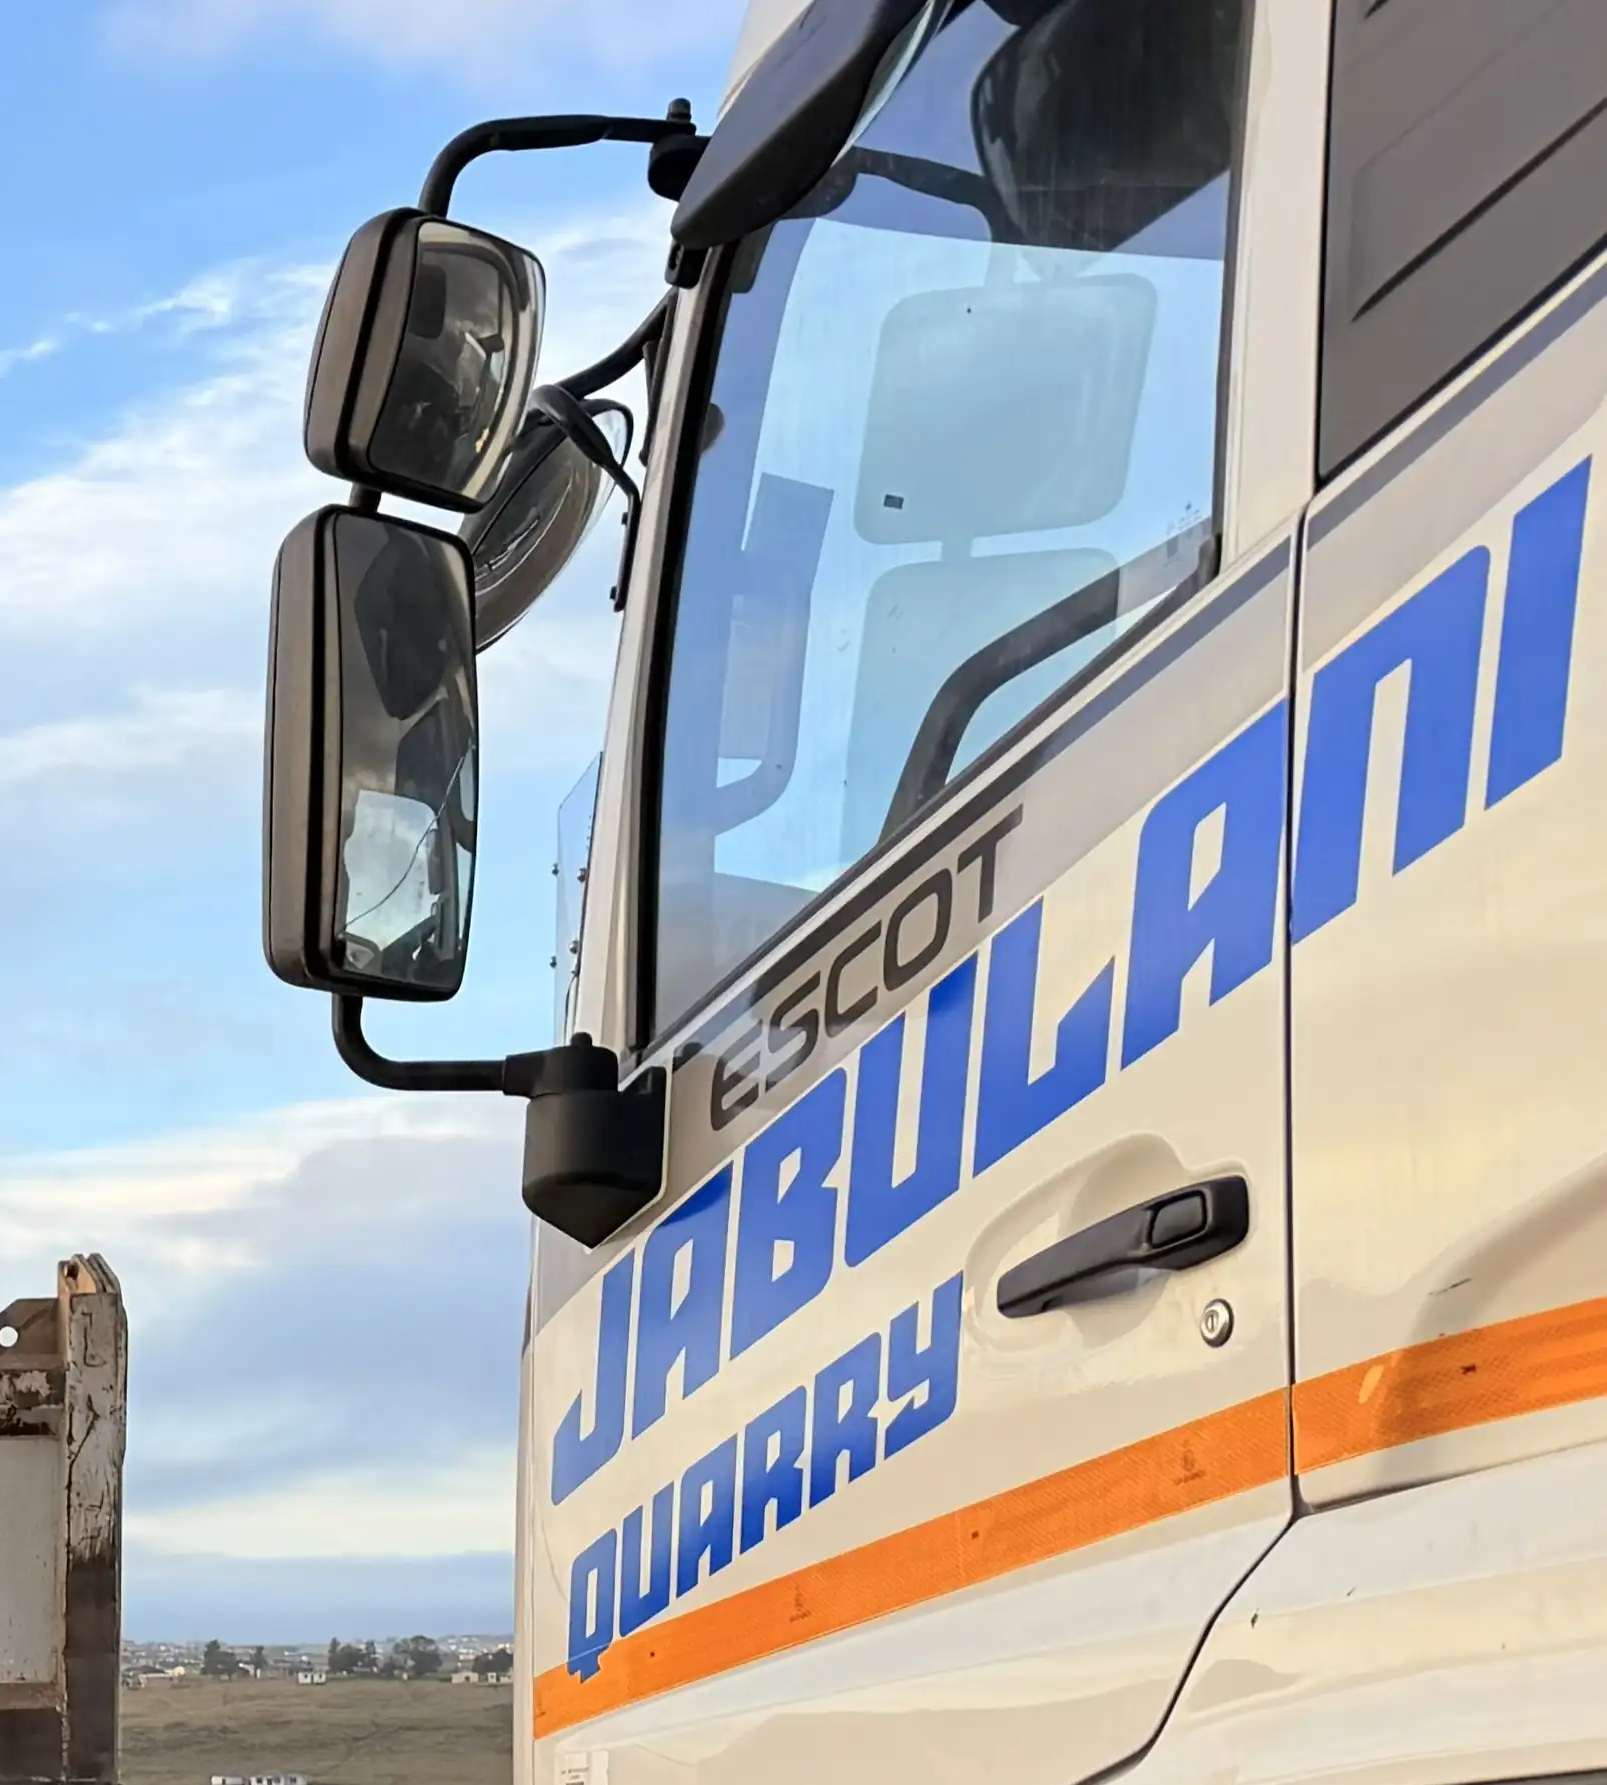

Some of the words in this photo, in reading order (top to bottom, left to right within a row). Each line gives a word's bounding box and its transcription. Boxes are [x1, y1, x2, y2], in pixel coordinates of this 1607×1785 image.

[551, 456, 1593, 1507] JABULANI
[710, 803, 1024, 1132] ESCOT
[565, 1270, 964, 1684] QUARRY
